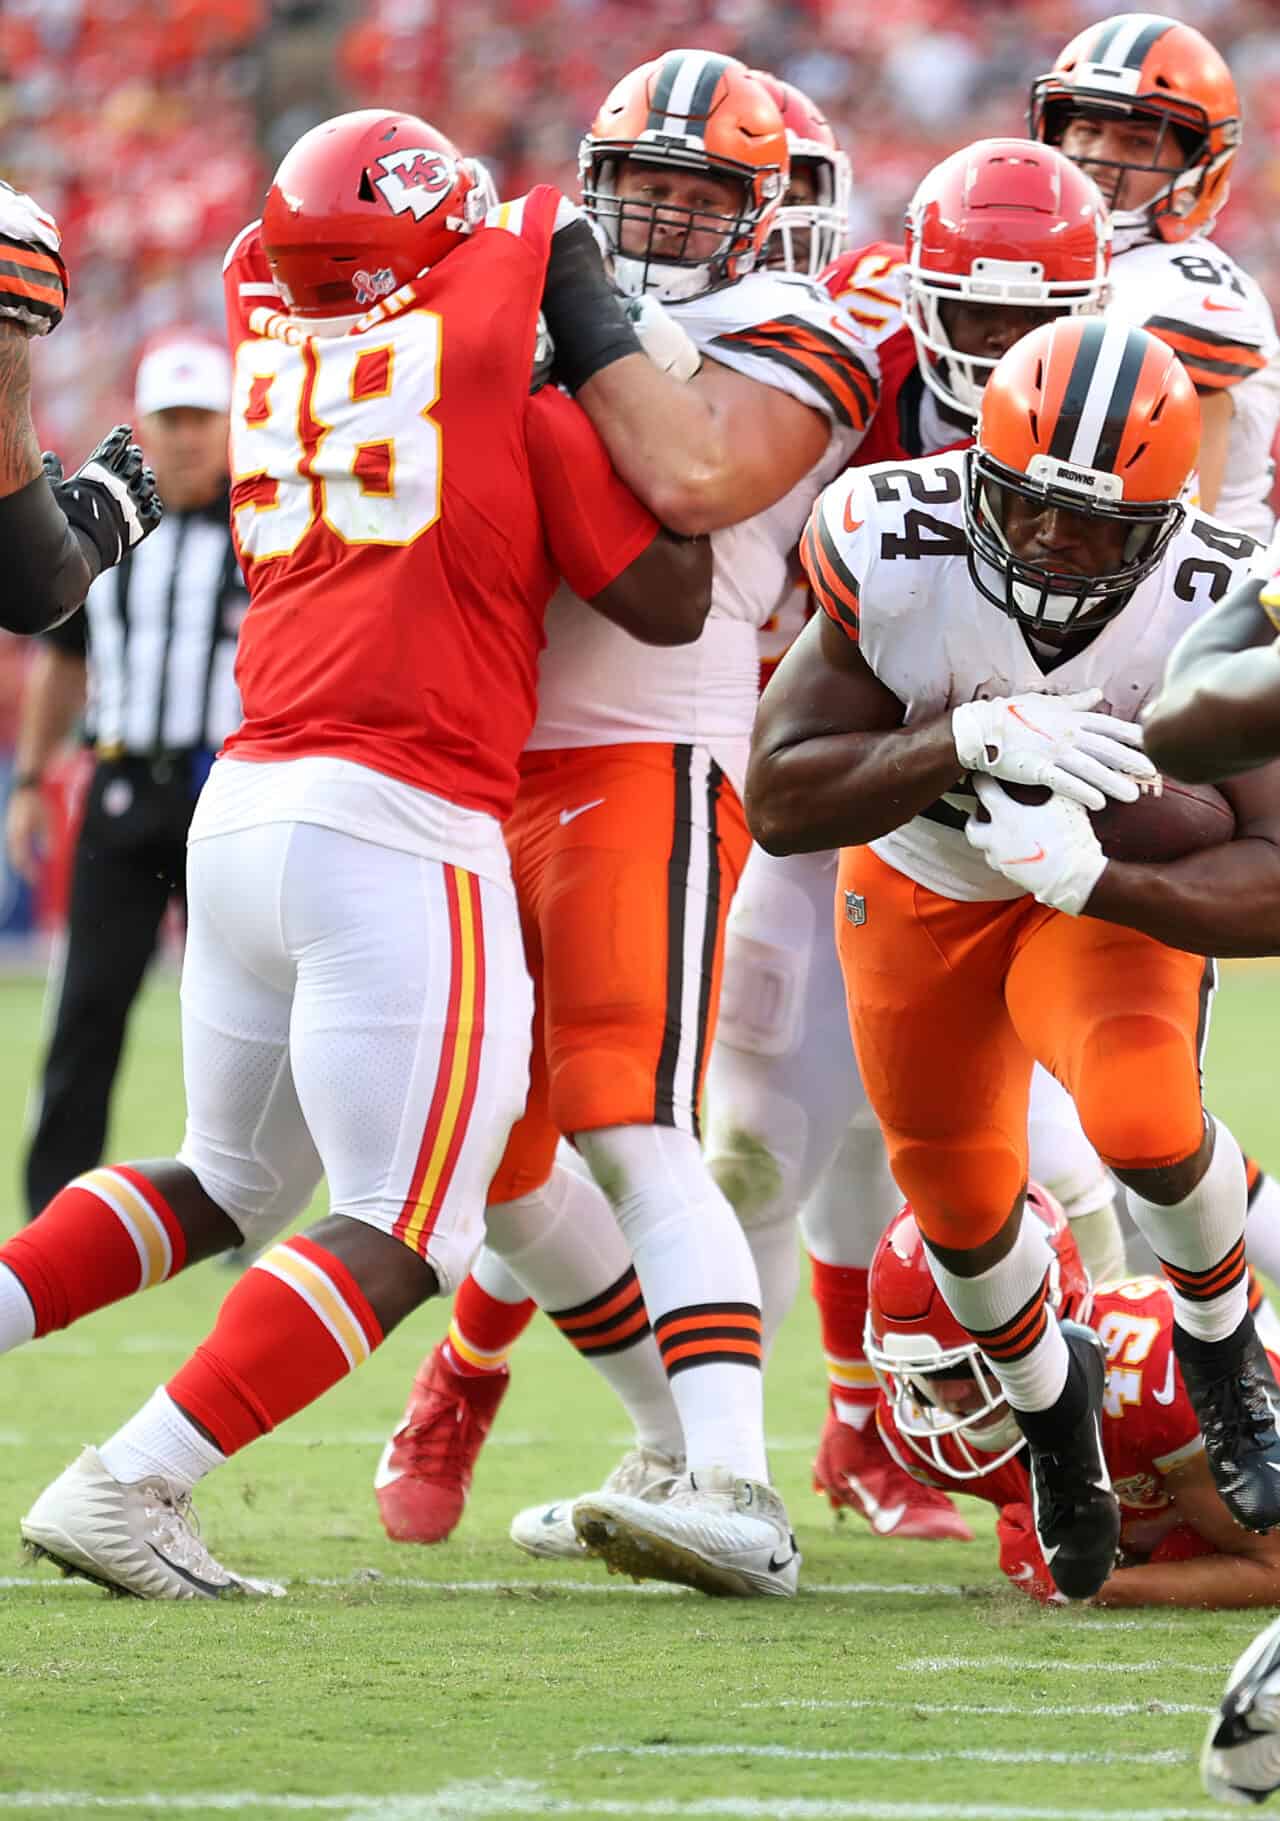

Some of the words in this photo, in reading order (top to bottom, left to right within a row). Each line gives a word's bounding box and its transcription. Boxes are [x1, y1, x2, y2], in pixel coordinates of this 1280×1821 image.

[391, 153, 449, 192] KC
[231, 308, 443, 563] 98
[1056, 466, 1096, 487] BROWNS
[868, 467, 970, 561] 24
[1173, 518, 1267, 605] 24
[1098, 1310, 1160, 1419] 49
